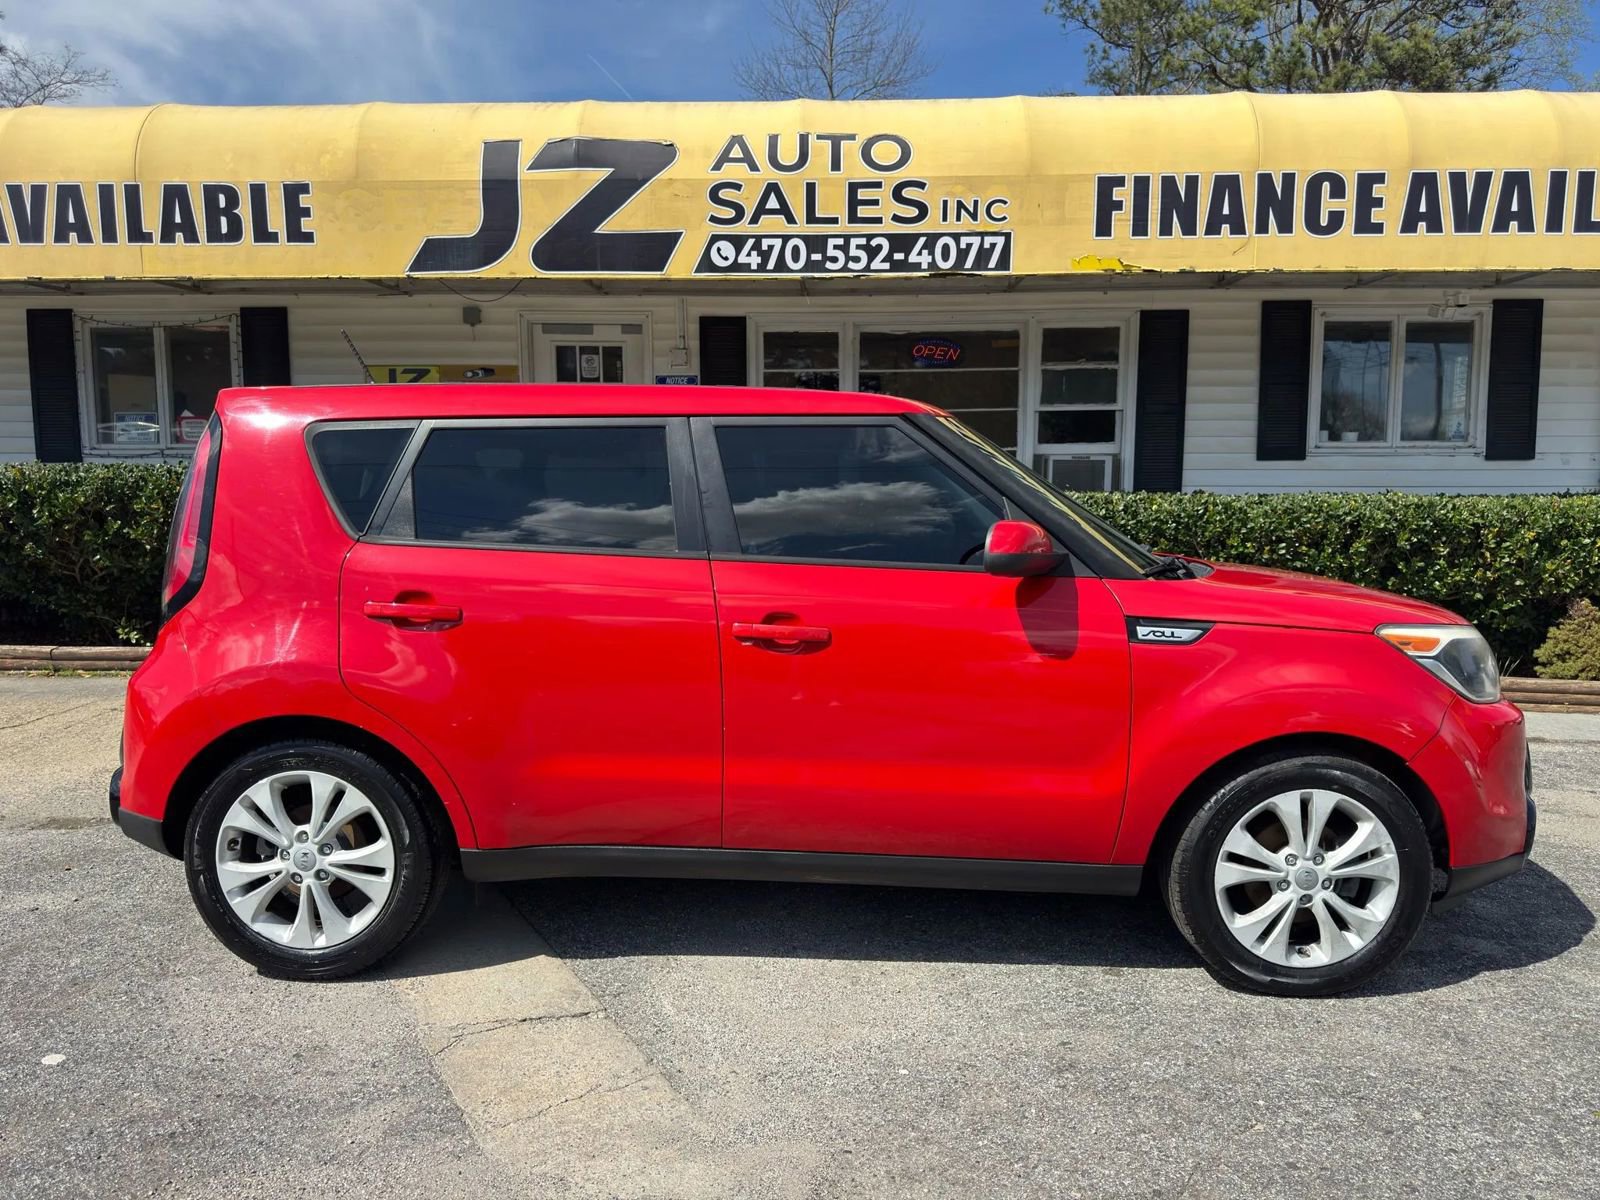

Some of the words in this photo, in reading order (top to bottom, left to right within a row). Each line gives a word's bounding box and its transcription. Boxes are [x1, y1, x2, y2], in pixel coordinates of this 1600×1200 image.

[707, 131, 913, 174] AUTO
[0, 182, 316, 245] VAILABLE
[404, 136, 686, 275] JZ
[706, 179, 929, 227] SALES
[940, 198, 1009, 224] INC
[1093, 169, 1388, 239] FINANCE
[737, 236, 1006, 270] 470-552-4077
[912, 344, 961, 361] OPEN
[665, 376, 689, 384] NOTICE
[1141, 630, 1183, 639] SOUL
